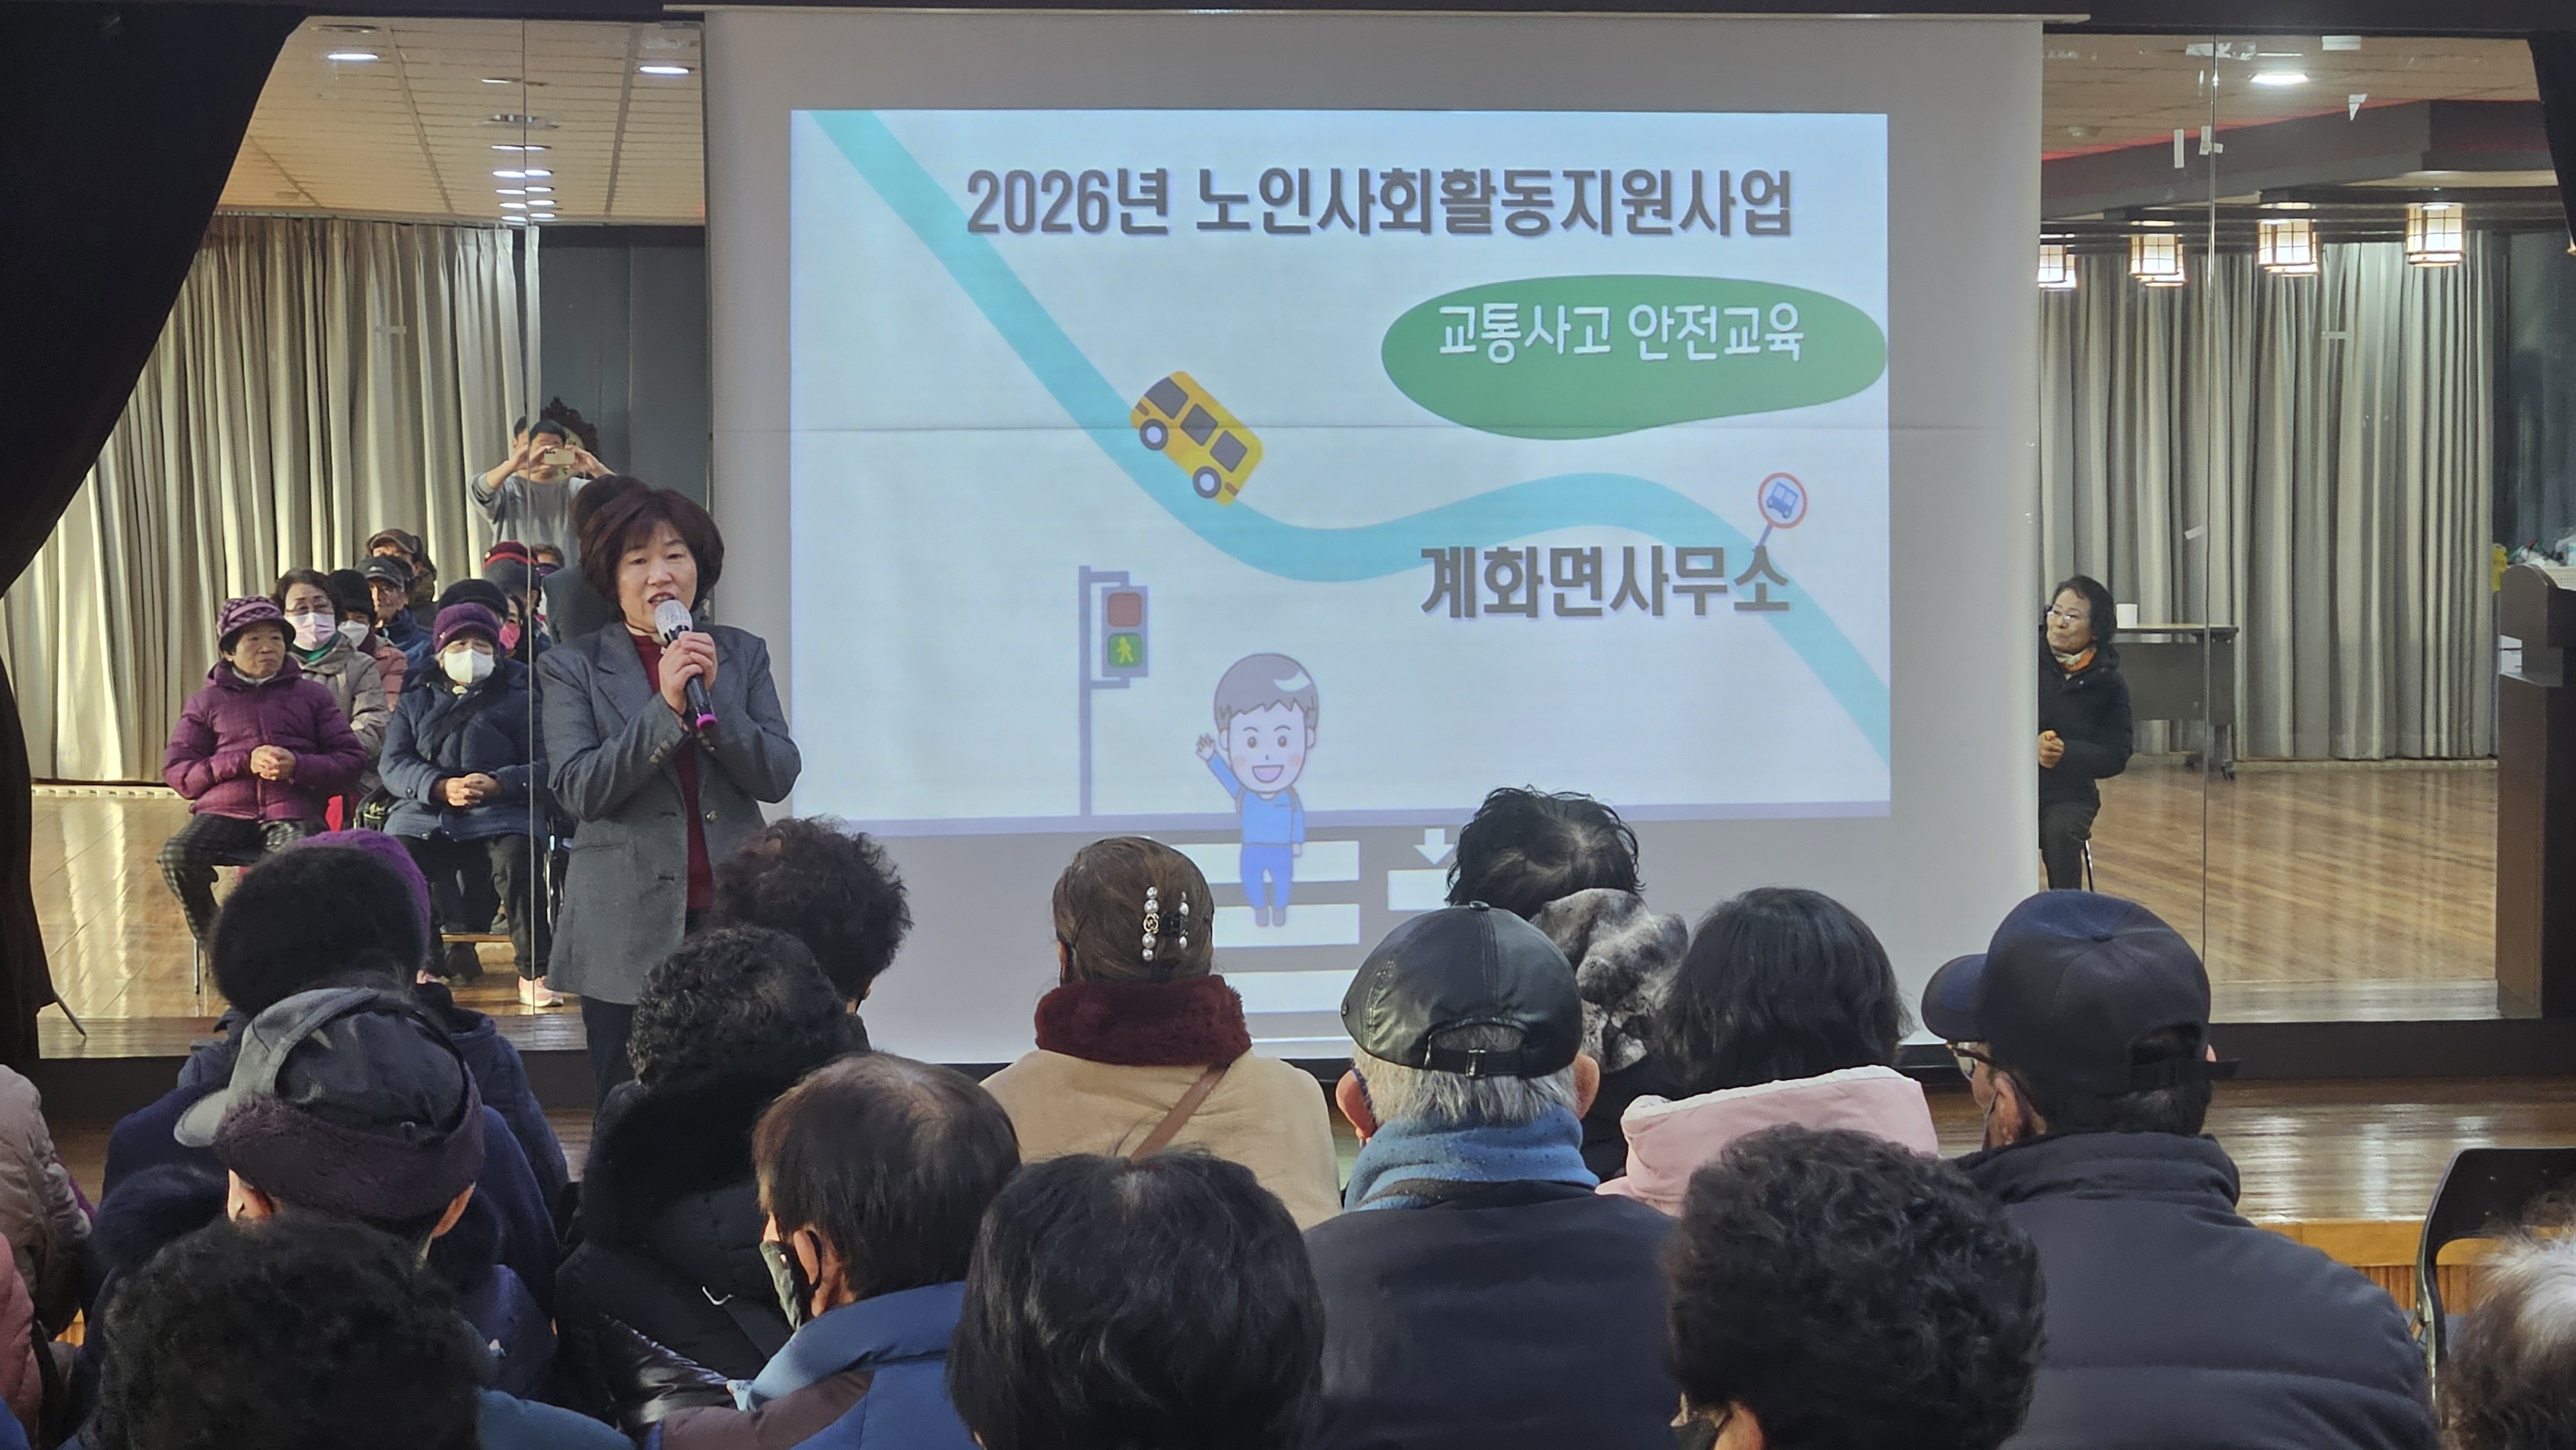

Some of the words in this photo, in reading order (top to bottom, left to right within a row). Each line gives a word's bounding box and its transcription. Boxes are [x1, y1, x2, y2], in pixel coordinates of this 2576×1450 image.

[967, 167, 1169, 235] 2026년
[1196, 167, 1792, 236] 노인사회활동지원사업
[1439, 303, 1612, 364] 교통사고
[1628, 302, 1805, 362] 안전교육
[1420, 545, 1791, 619] 계화면사무소
